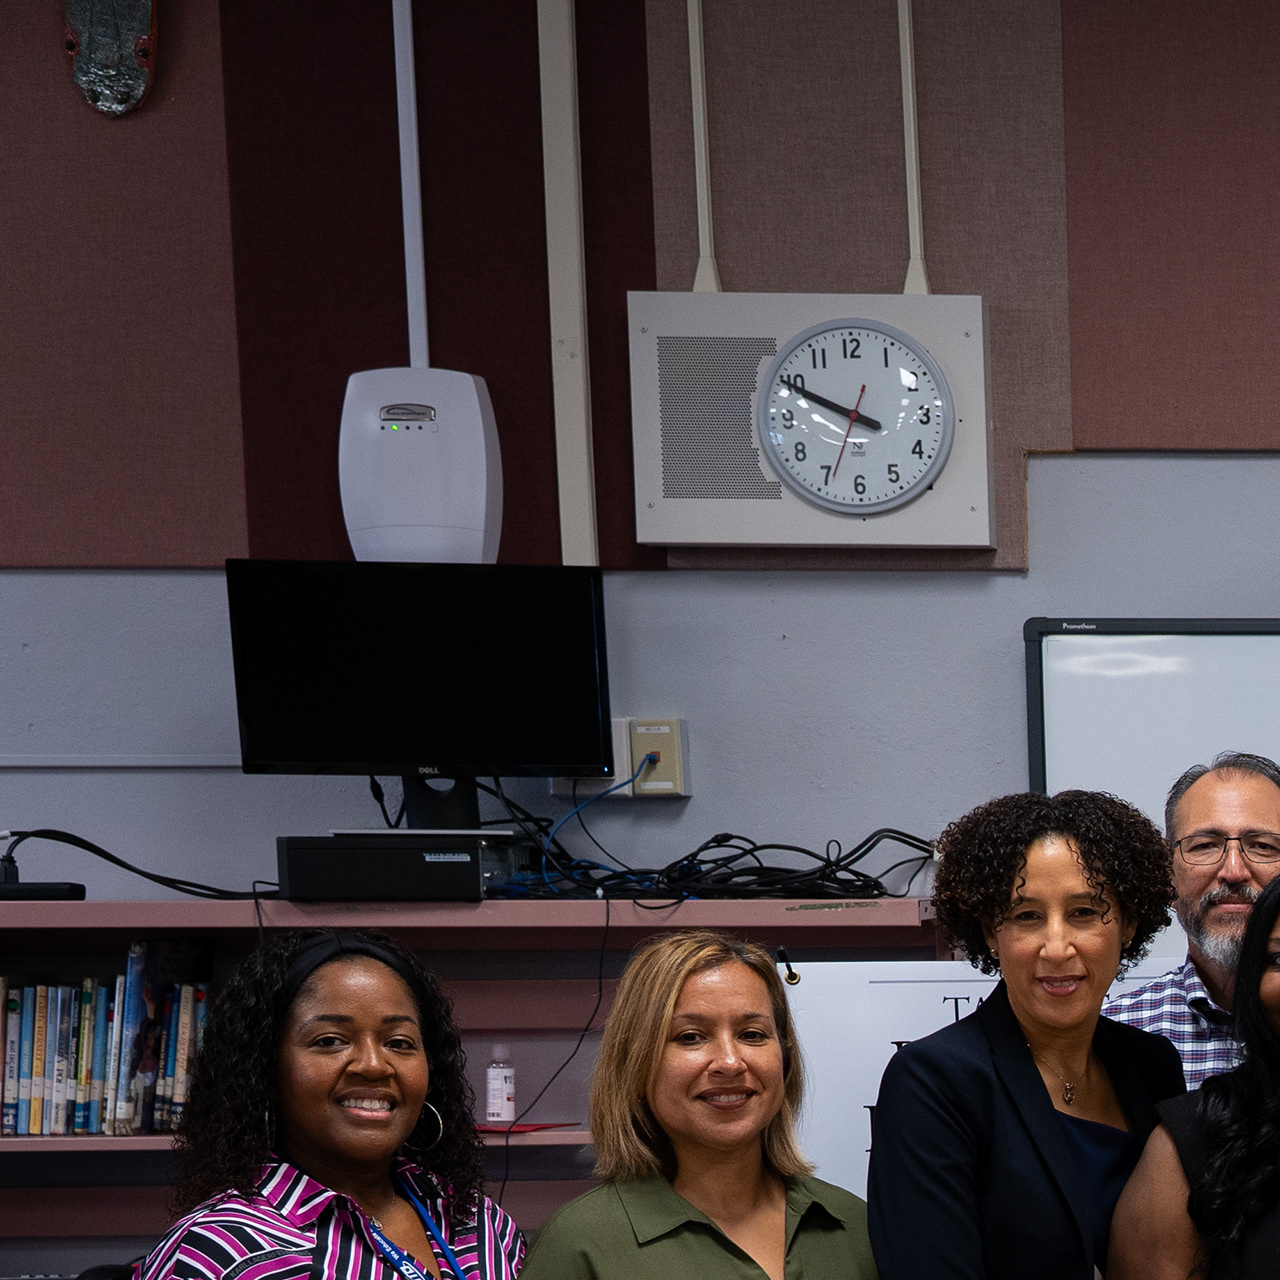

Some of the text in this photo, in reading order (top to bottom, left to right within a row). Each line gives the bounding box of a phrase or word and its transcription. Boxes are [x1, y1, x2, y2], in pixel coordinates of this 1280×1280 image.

[811, 348, 826, 369] 11
[842, 338, 861, 359] 12
[883, 347, 889, 368] 1
[786, 373, 805, 395] 10
[781, 409, 794, 430] 9
[918, 404, 931, 425] 3
[794, 442, 807, 462] 8
[911, 439, 924, 460] 4
[820, 465, 832, 486] 7
[887, 464, 900, 484] 5
[853, 475, 866, 495] 6
[1062, 622, 1097, 630] Promethean
[418, 766, 440, 774] DELL
[371, 1231, 392, 1253] Educate
